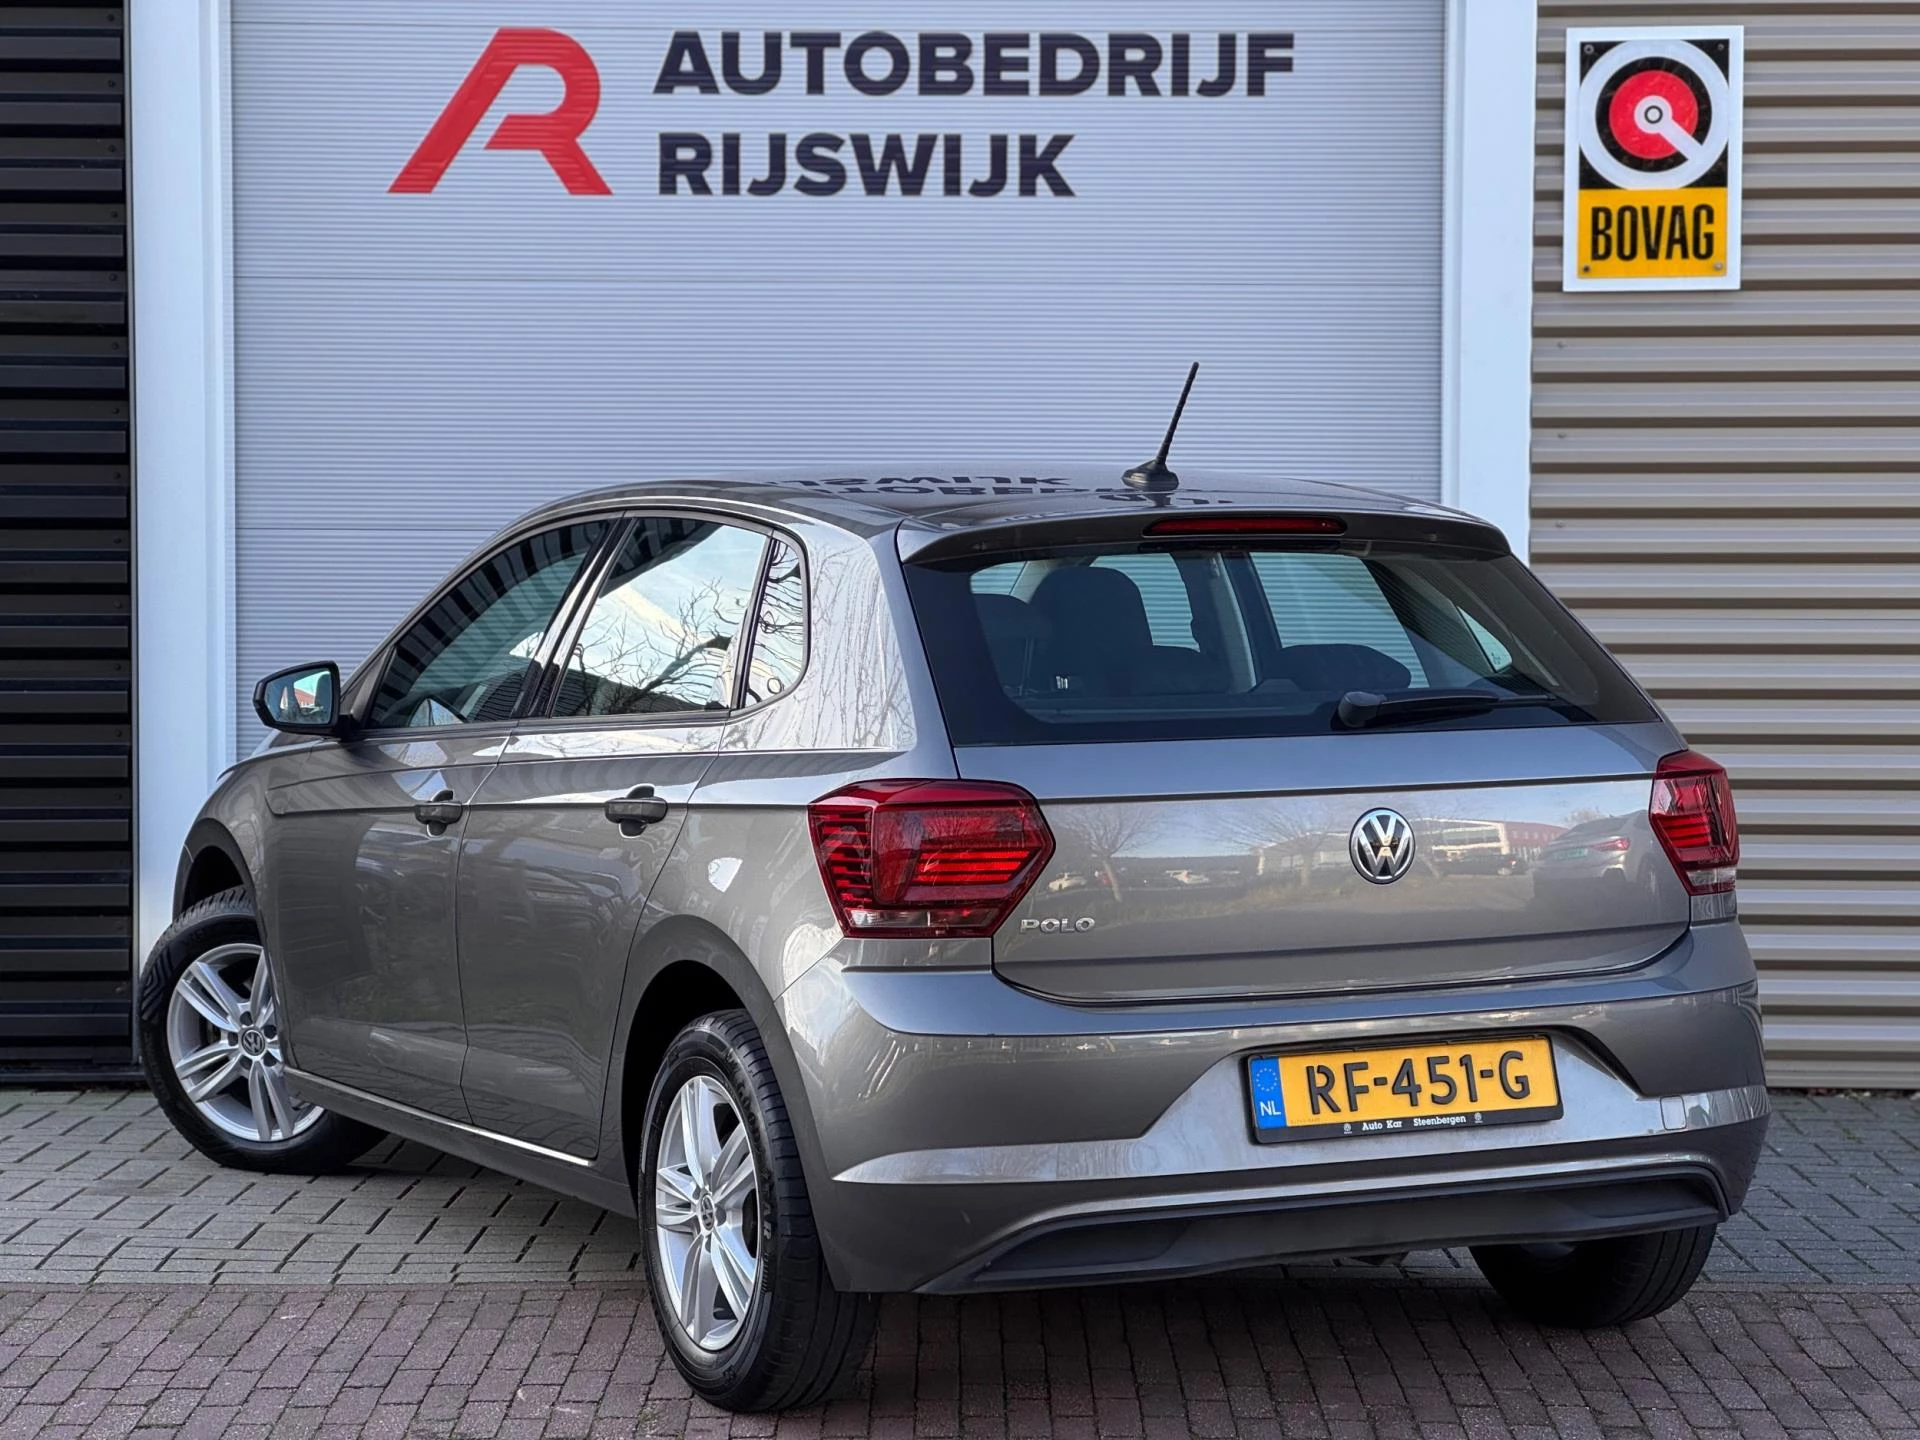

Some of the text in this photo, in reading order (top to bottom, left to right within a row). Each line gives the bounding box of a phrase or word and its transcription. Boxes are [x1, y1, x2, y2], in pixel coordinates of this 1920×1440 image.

[653, 31, 1294, 97] AUTOBEDRIJF
[658, 132, 1076, 197] RIJSWIJK
[1591, 204, 1714, 261] BOVAG
[1019, 917, 1096, 934] POLO
[1260, 1101, 1281, 1117] NL
[1306, 1050, 1531, 1115] RF-451-G
[1362, 1121, 1383, 1131] Auto
[1413, 1115, 1466, 1126] Steenbergen
